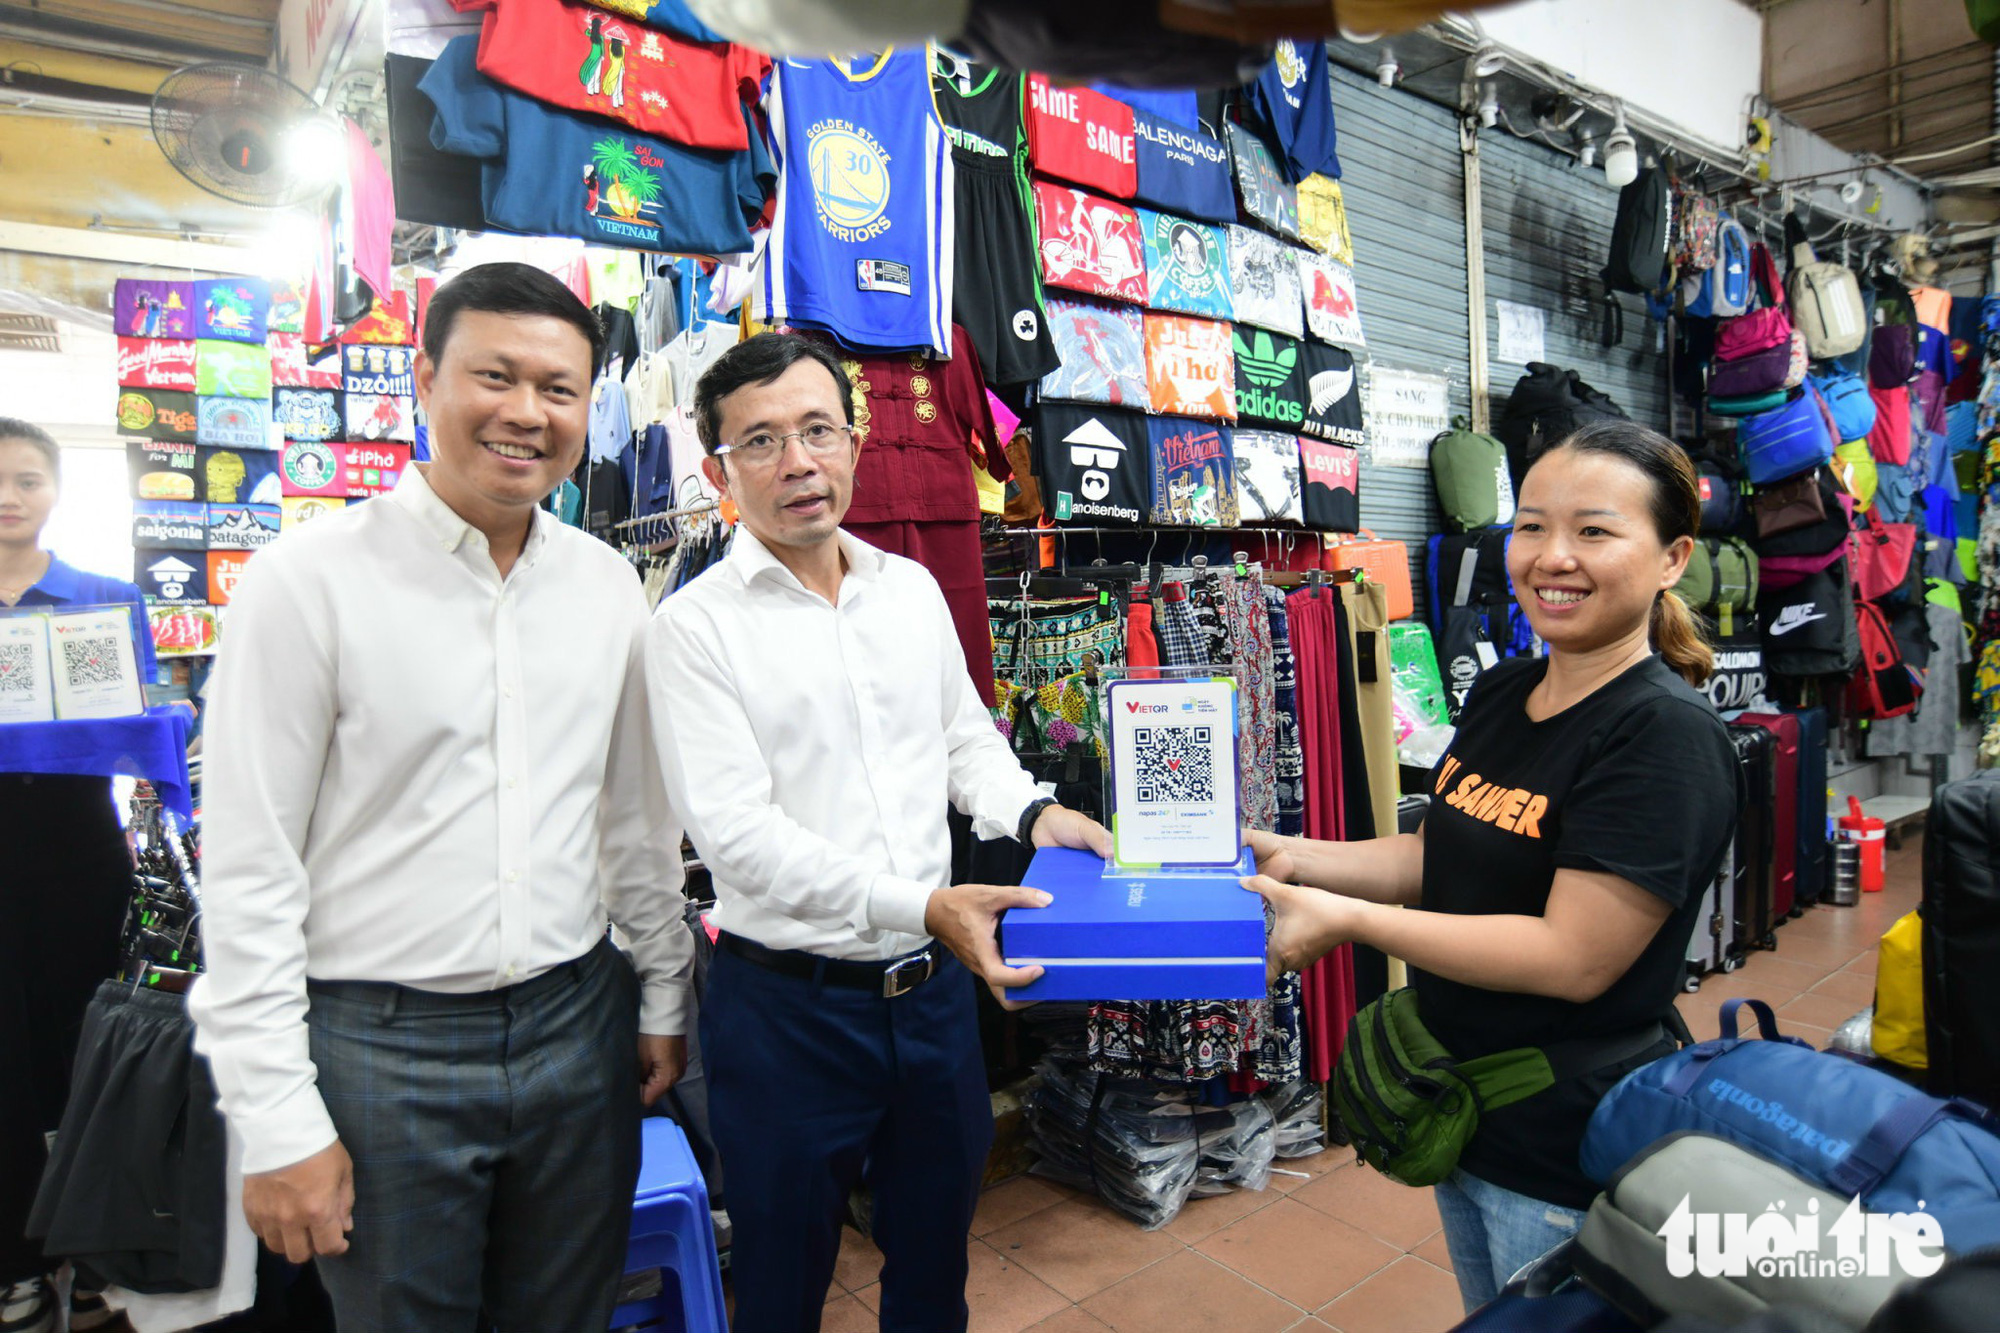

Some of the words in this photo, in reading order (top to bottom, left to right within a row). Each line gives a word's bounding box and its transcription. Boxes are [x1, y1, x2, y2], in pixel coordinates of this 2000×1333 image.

[1030, 81, 1080, 124] SAME
[634, 145, 652, 157] SAI
[806, 118, 854, 139] GOLDEN
[857, 127, 892, 165] STATE
[1086, 121, 1134, 164] SAME
[640, 156, 664, 168] GON
[845, 150, 871, 175] 30
[1166, 150, 1195, 166] PARIS
[597, 219, 659, 241] VIETNAM
[1171, 266, 1213, 293] COFFEE
[1235, 388, 1303, 423] adidas
[1323, 424, 1365, 446] BLACKS
[148, 453, 168, 462] for
[1163, 430, 1223, 466] Vietnam
[1779, 602, 1816, 623] NIKE
[1125, 701, 1169, 714] VIETQR
[1138, 809, 1157, 818] napas
[1445, 773, 1548, 839] SANDER
[1707, 1077, 1851, 1160] patagonia
